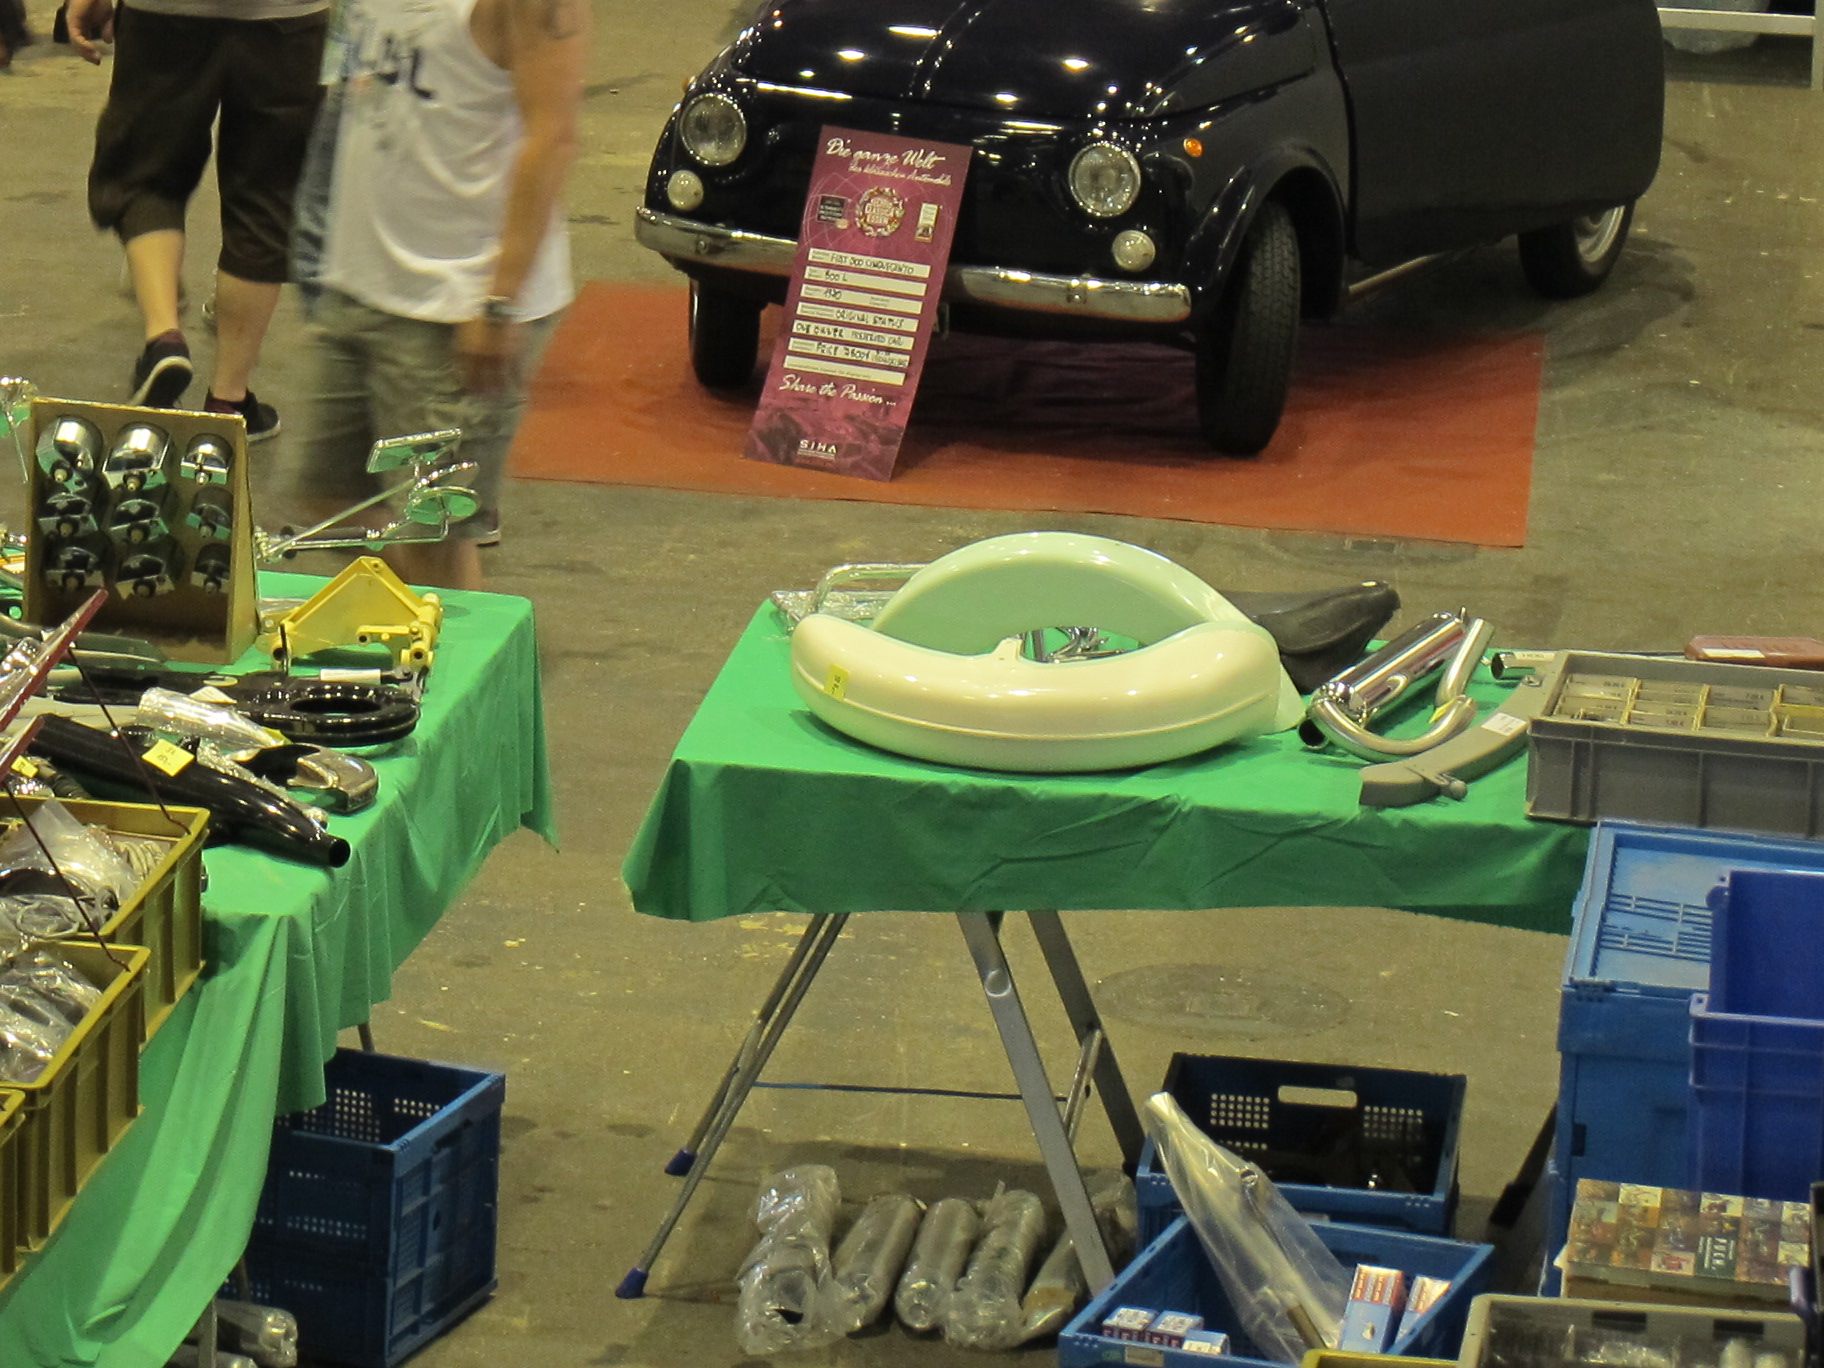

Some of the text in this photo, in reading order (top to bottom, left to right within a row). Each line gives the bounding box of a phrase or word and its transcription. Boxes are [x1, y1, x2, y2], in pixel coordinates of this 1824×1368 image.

[827, 137, 947, 170] Die ganze Welt
[779, 374, 817, 394] Share
[818, 382, 838, 397] the
[840, 383, 883, 404] Passion
